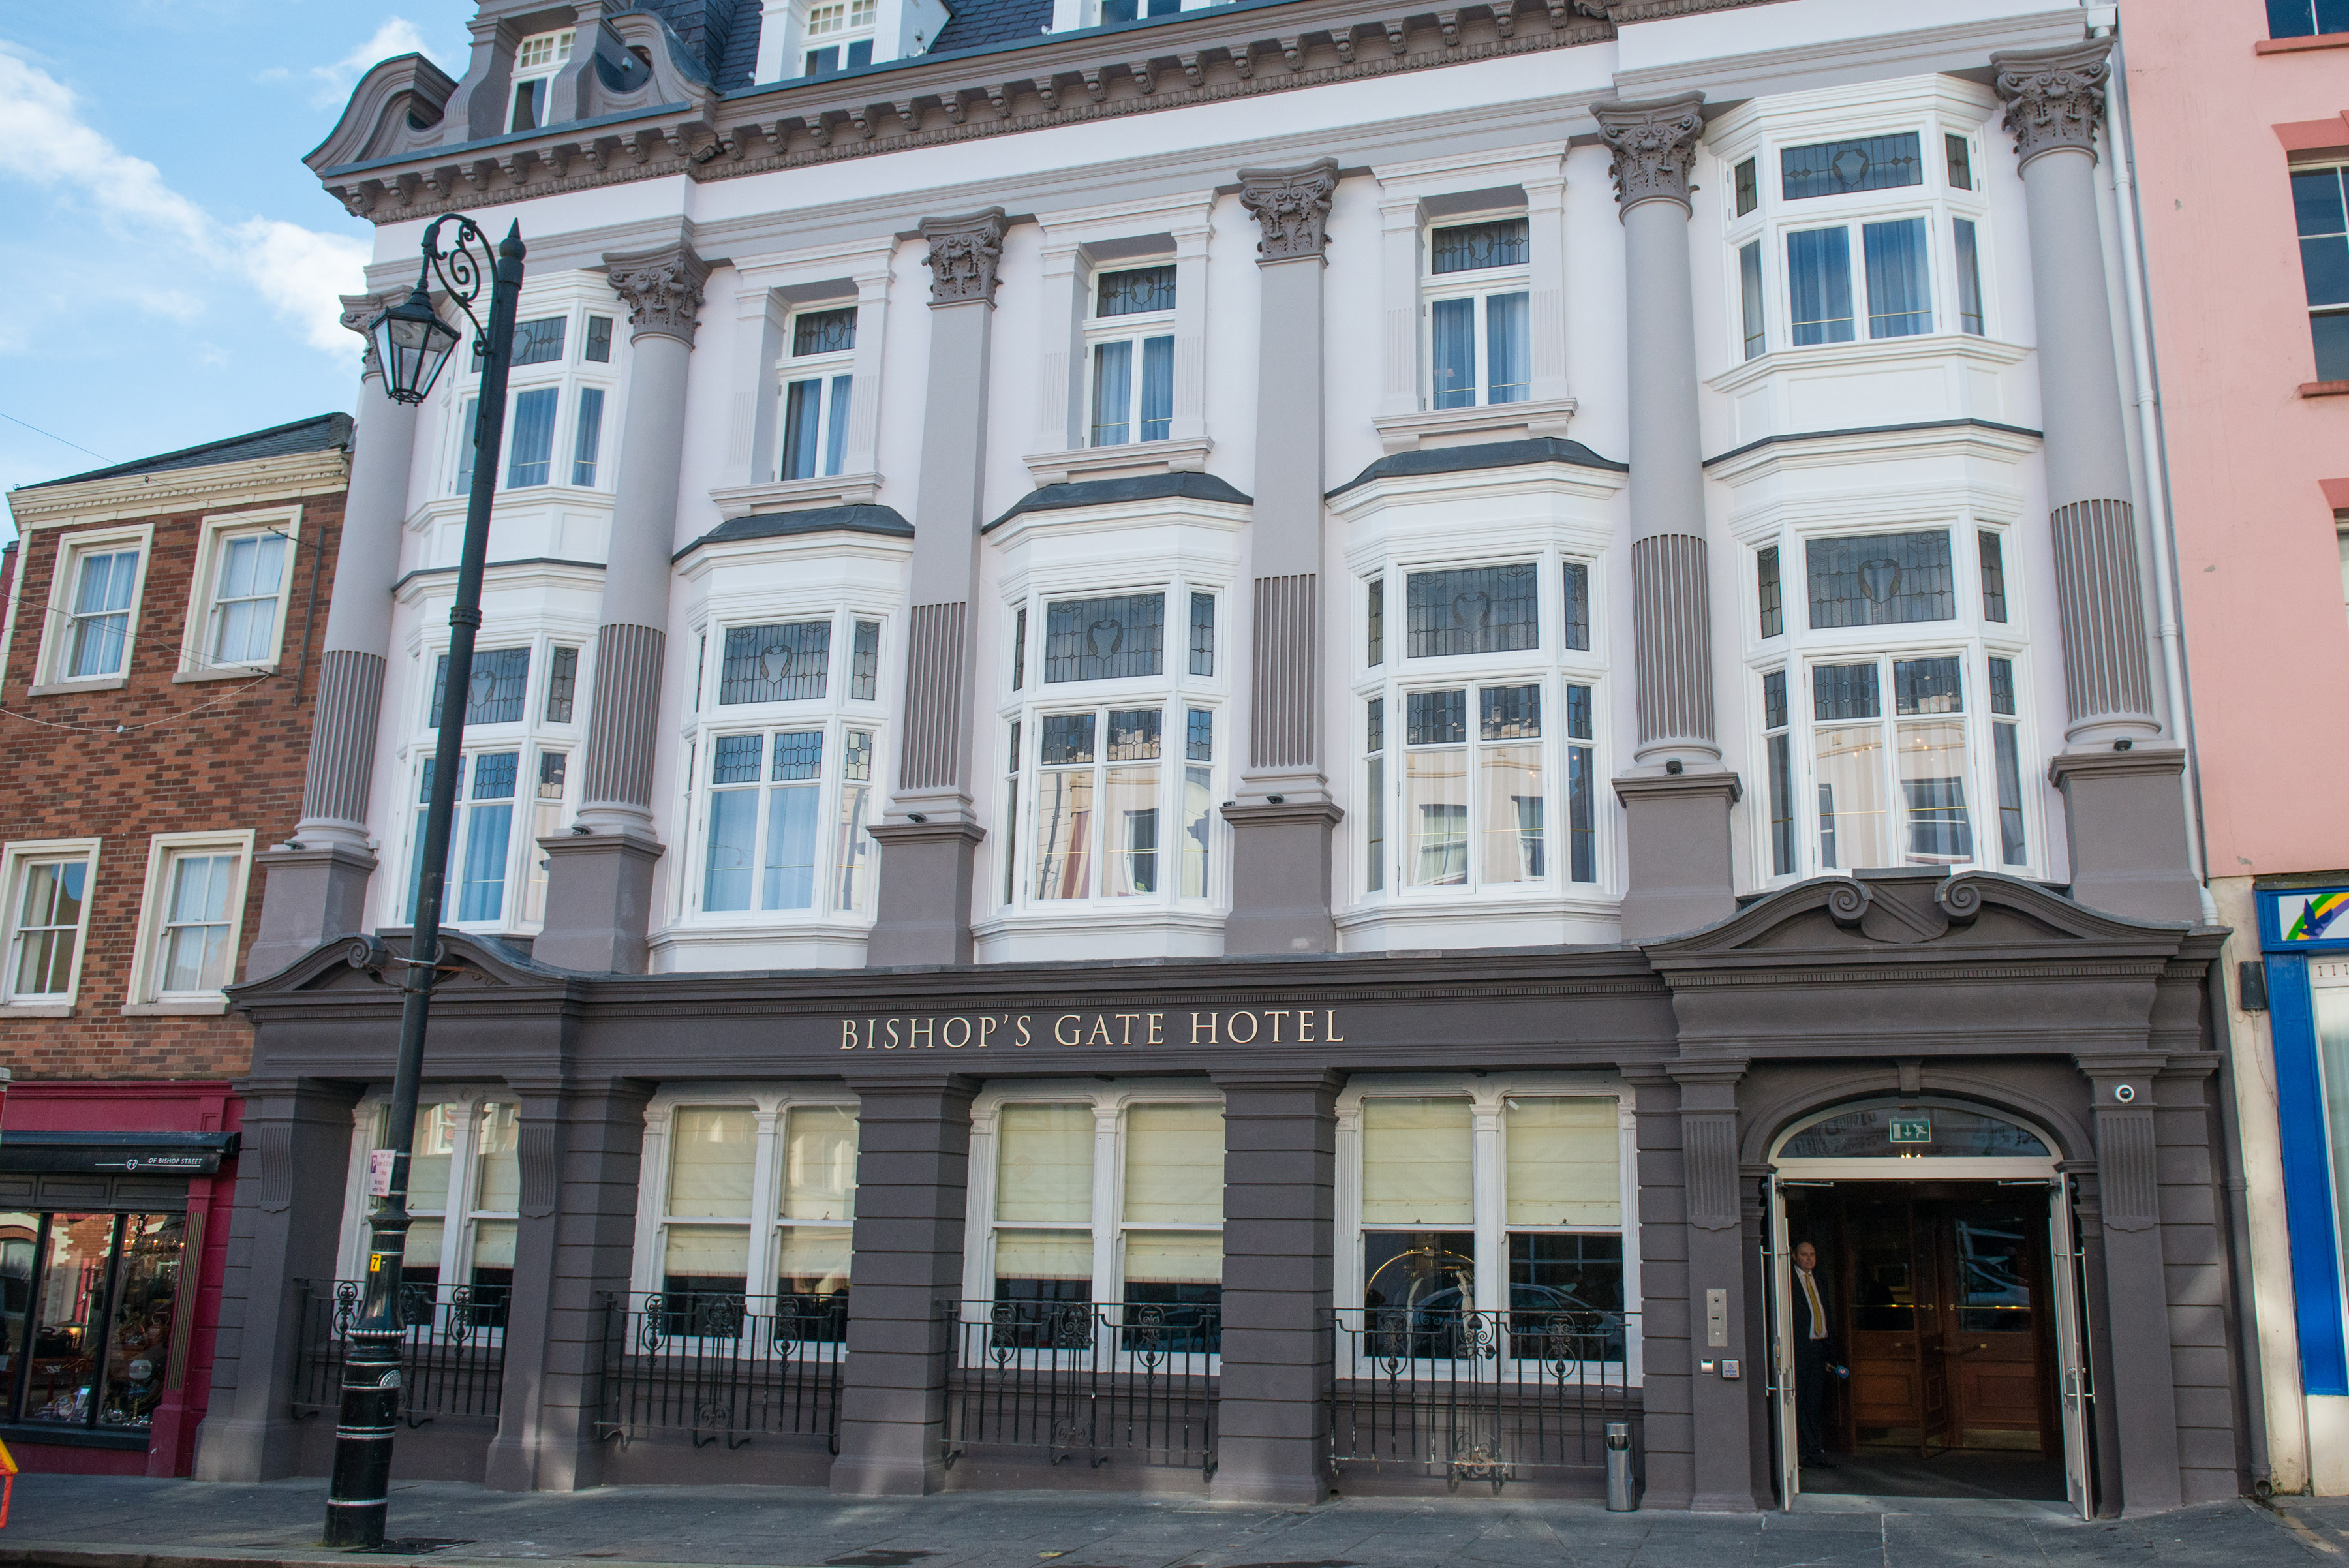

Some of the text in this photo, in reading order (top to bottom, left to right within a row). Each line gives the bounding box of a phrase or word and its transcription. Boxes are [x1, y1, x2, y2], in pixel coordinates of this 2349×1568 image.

[840, 1009, 1345, 1050] BISHOP'S GATE HOTEL
[373, 1257, 379, 1268] 7
